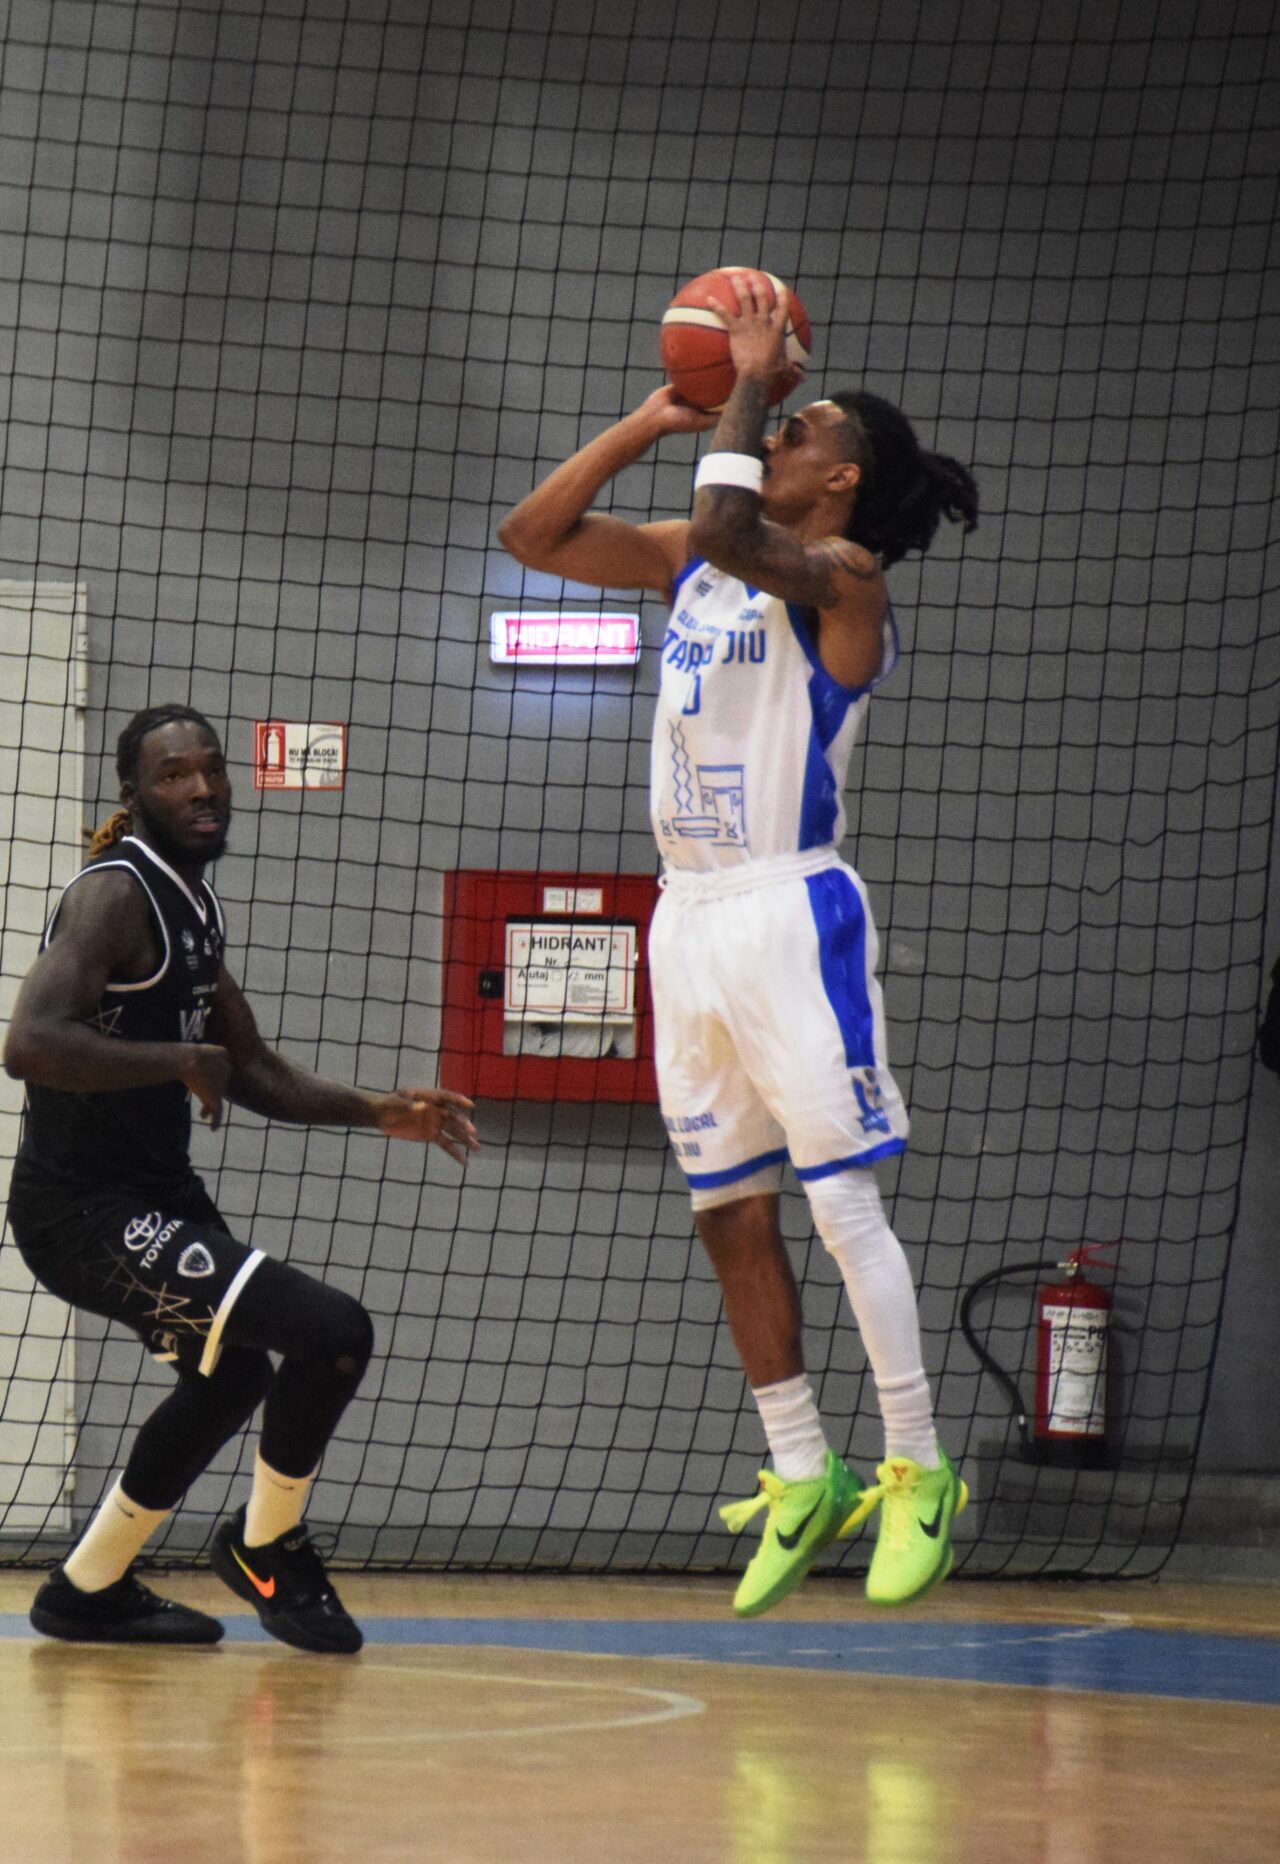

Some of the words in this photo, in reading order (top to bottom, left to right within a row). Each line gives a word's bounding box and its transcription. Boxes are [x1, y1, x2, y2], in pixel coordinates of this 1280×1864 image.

[508, 624, 632, 650] HIDRANT
[531, 936, 607, 951] HIDRANT
[518, 970, 549, 981] Autaj
[139, 1219, 184, 1270] TOYOTA
